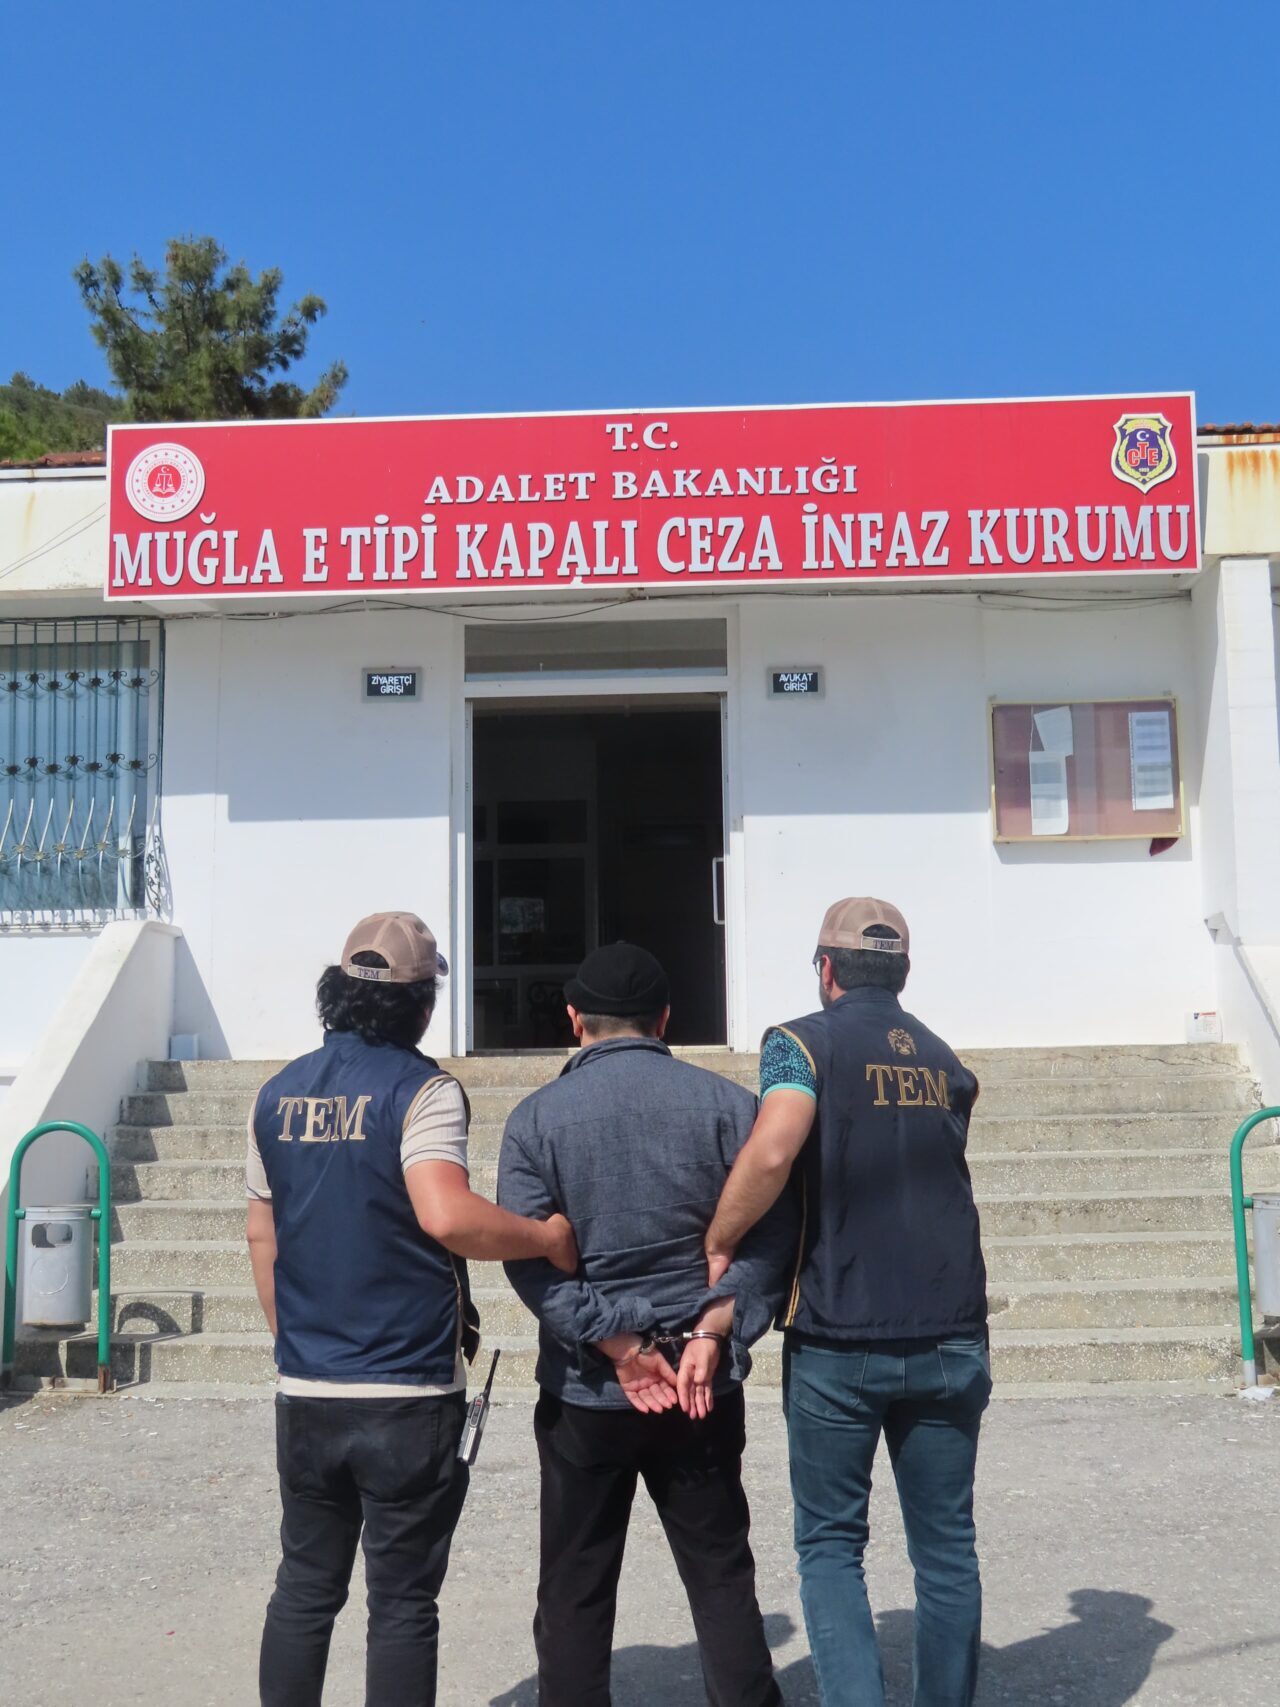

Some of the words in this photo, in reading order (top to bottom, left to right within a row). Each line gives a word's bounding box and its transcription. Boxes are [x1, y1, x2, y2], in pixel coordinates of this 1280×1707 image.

[605, 422, 679, 452] T.C.
[1127, 442, 1159, 467] CTE
[424, 472, 596, 505] ADALET
[611, 457, 860, 500] BAKANLIĞI
[112, 512, 284, 588] MUĞLA
[302, 528, 329, 582] E
[341, 514, 438, 582] TİPİ
[455, 519, 639, 580] KAPALI
[656, 514, 783, 573] CEZA
[801, 503, 951, 570] İNFAZ
[967, 505, 1191, 566] KURUMU
[371, 675, 412, 686] ZİYARETÇİ
[779, 672, 813, 682] AVUKAT
[873, 939, 895, 949] TEM
[358, 967, 380, 979] TEM
[866, 1064, 951, 1111] TEM
[277, 1095, 372, 1142] TEM
